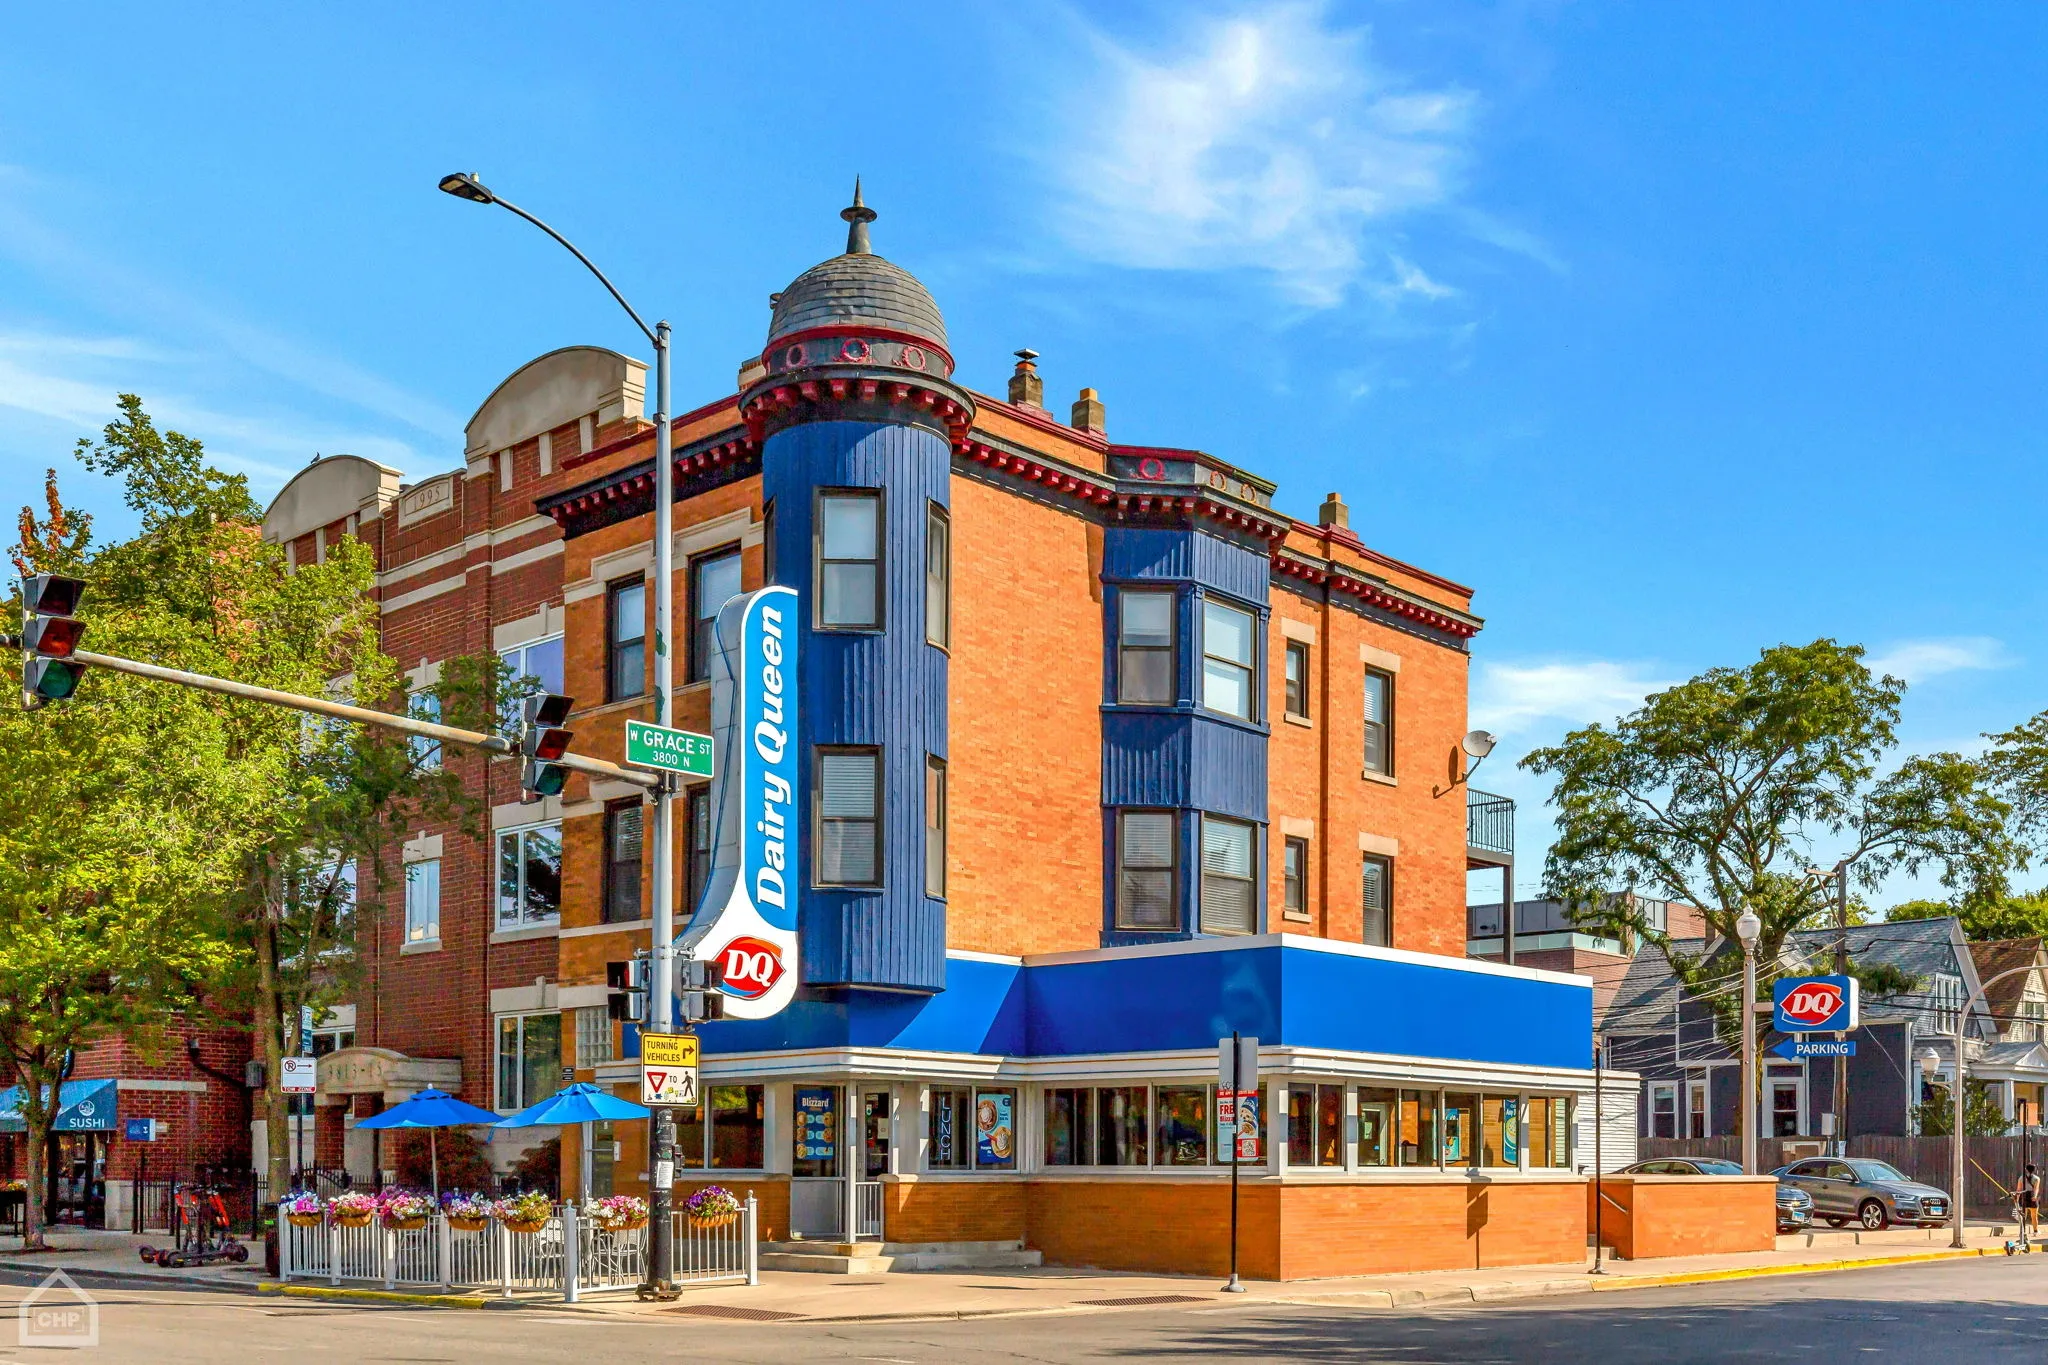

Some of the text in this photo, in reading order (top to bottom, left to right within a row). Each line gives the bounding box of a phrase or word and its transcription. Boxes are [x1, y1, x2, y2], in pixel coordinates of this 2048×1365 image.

[414, 486, 440, 509] 1995
[630, 730, 710, 755] W GRACE ST
[652, 751, 690, 767] 3800 N
[755, 605, 791, 910] Dairy Queen
[724, 949, 774, 987] DQ
[1790, 992, 1834, 1016] DQ
[646, 1041, 679, 1050] TURNING
[1796, 1043, 1849, 1054] PARKING
[646, 1053, 680, 1062] VEHICLES
[802, 1097, 829, 1107] Blizzard
[1219, 1104, 1234, 1115] FRE
[69, 1118, 105, 1128] SUSHI
[940, 1096, 951, 1160] LUNCH
